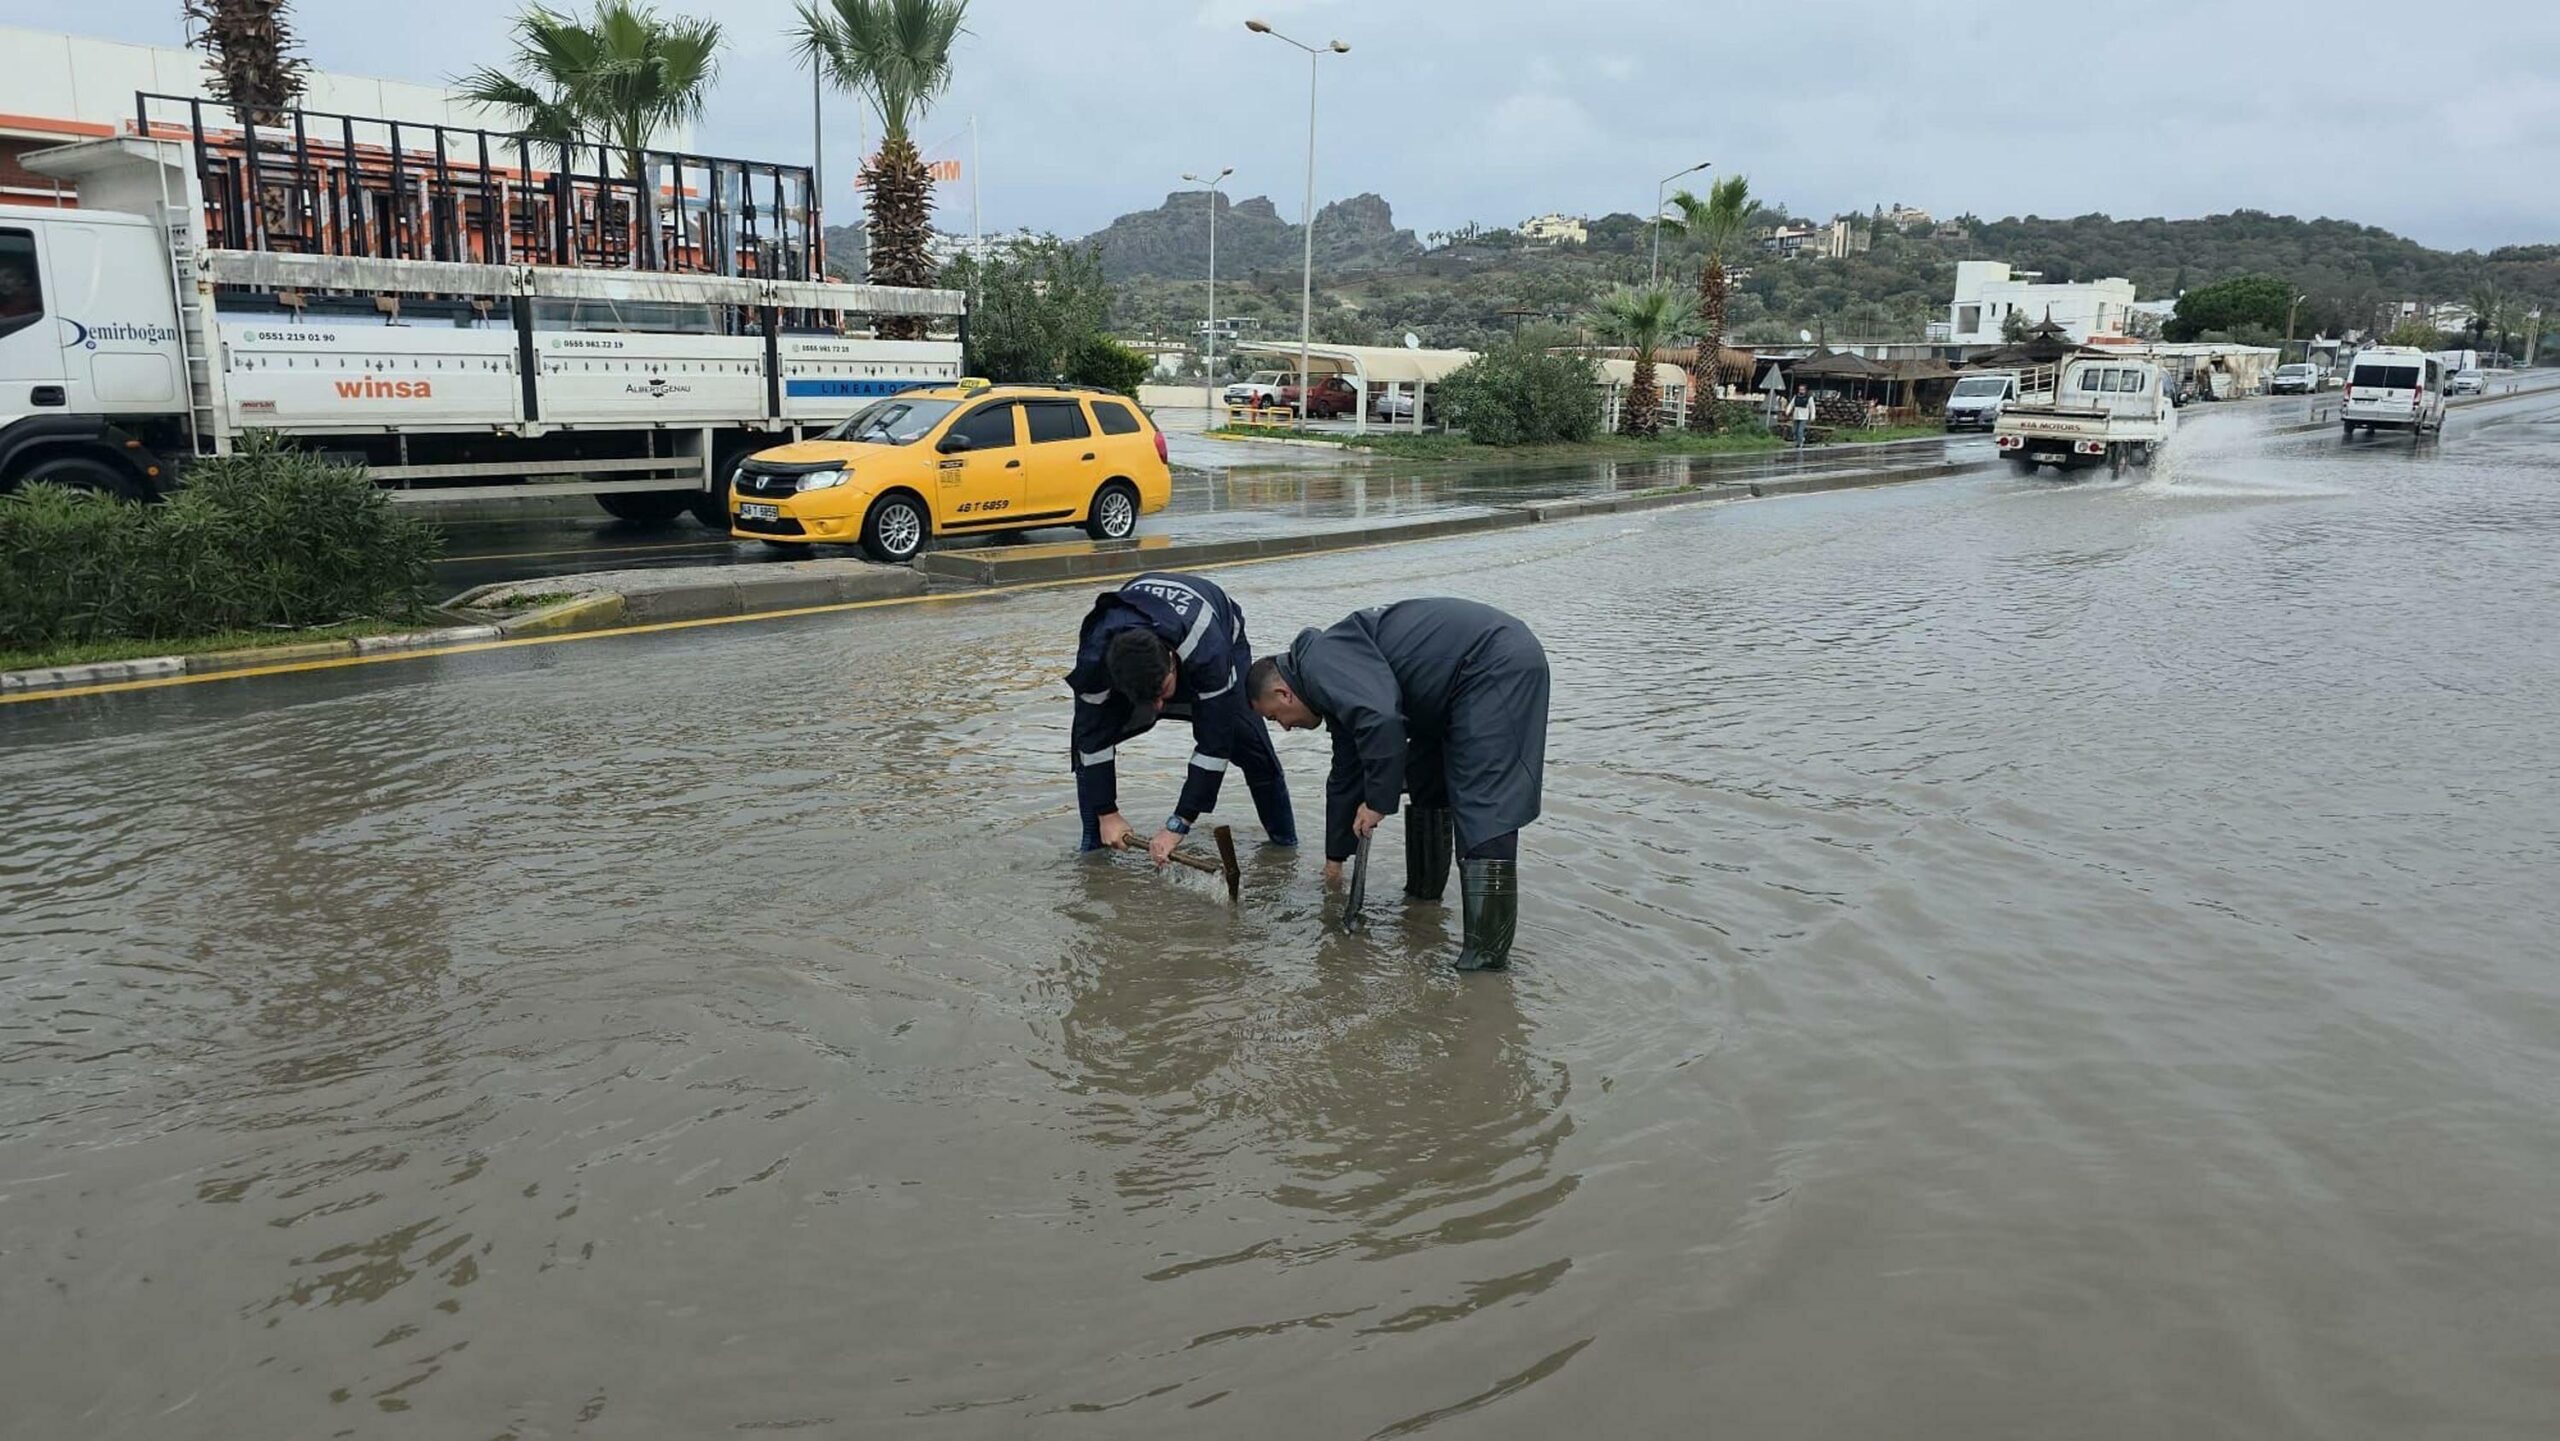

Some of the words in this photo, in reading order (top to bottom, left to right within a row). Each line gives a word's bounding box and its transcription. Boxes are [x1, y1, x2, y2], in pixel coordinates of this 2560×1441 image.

[54, 316, 176, 348] Demirboğan
[258, 331, 284, 340] 0551
[286, 333, 306, 341] 219
[307, 333, 321, 341] 01
[322, 334, 335, 342] 90
[335, 375, 431, 398] winsa
[821, 384, 872, 394] LINEA
[2038, 423, 2081, 431] MOTORS
[957, 502, 972, 512] 48
[974, 502, 981, 511] T
[982, 499, 1009, 511] 6859
